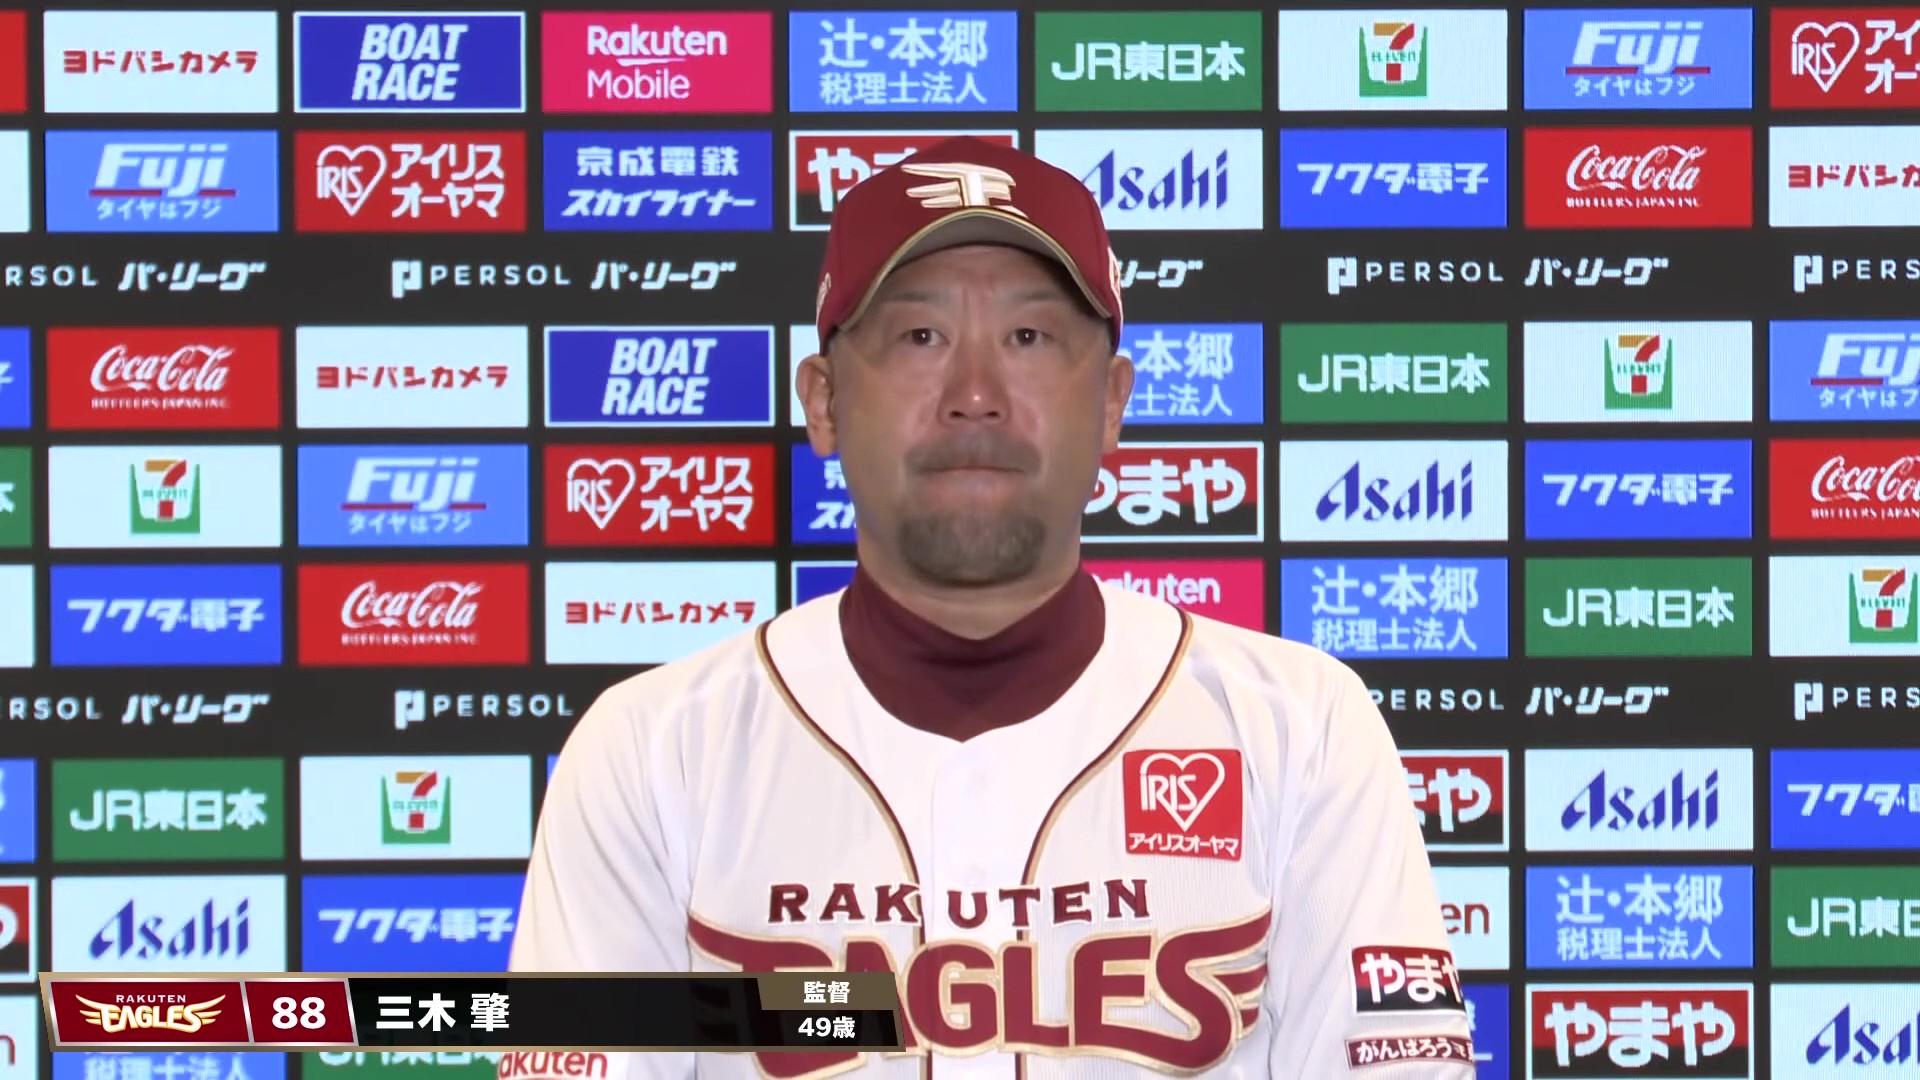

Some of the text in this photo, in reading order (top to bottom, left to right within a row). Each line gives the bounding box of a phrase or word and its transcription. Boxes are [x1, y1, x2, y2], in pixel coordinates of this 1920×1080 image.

[360, 23, 468, 61] BOAT
[588, 24, 727, 56] Rakuten
[820, 18, 987, 67] 辻・本郷
[1571, 21, 1704, 74] Fuji
[1864, 20, 1920, 55] アイ
[64, 51, 257, 73] ヨドバシカメラ
[1052, 41, 1245, 81] JR東日本
[1864, 58, 1920, 93] オー
[352, 63, 460, 100] RACE
[588, 68, 690, 98] Mobile
[1575, 76, 1694, 96] タイヤはフジ
[95, 143, 229, 197] Fuji
[391, 144, 504, 181] アイリス
[578, 146, 738, 176] 京成電鉄
[1298, 163, 1488, 194] フクダ電子
[1789, 165, 1920, 188] ヨドバシカ
[1082, 148, 1228, 211] Asahi
[97, 198, 221, 219] タイヤはフジ
[392, 182, 504, 217] オーヤマ
[562, 189, 755, 216] スカイライナー
[6, 266, 96, 286] RSOL
[431, 265, 570, 285] PERSOL
[1120, 258, 1204, 288] リーグ
[1366, 262, 1503, 281] PERSOL
[1833, 260, 1920, 279] PERS
[610, 337, 717, 376] BOAT
[1134, 330, 1235, 380] 本郷
[1817, 333, 1920, 386] Fuj
[317, 366, 507, 388] ヨドバシカメラ
[1298, 353, 1489, 393] JR東日本
[602, 376, 709, 415] RACE
[1131, 384, 1234, 417] 士法人
[1820, 386, 1918, 408] タイヤはフ
[346, 457, 481, 512] Fuji
[640, 457, 752, 494] アイリス
[1316, 461, 1472, 521] Asahi
[1543, 474, 1733, 505] フクダ電子
[1811, 455, 1920, 502] Coca-Co
[350, 511, 471, 533] タイヤはフジ
[641, 495, 753, 531] オーヤマ
[1105, 571, 1221, 604] kuten
[1312, 565, 1478, 614] 辻・本郷
[68, 599, 264, 632] フクダ電子
[566, 602, 755, 623] ヨドバシカメラ
[1543, 586, 1734, 628] JR東日本
[10, 698, 98, 720] RSOL
[433, 695, 574, 717] PERSOL
[1369, 688, 1504, 711] PERSOL
[1833, 687, 1920, 708] PERS
[70, 789, 266, 831] JR東日本
[1561, 770, 1718, 830] Asahi
[1788, 784, 1920, 816] フクダ
[1128, 832, 1239, 858] アイリスオーヤマ
[767, 878, 1151, 928] RAKUTEN
[1556, 874, 1723, 923] 辻・本郷
[90, 899, 248, 958] Asahi
[319, 908, 514, 943] フクダ電子
[1544, 1001, 1735, 1067] やまや
[1806, 1003, 1920, 1065] Asa
[500, 1052, 608, 1078] akuten
